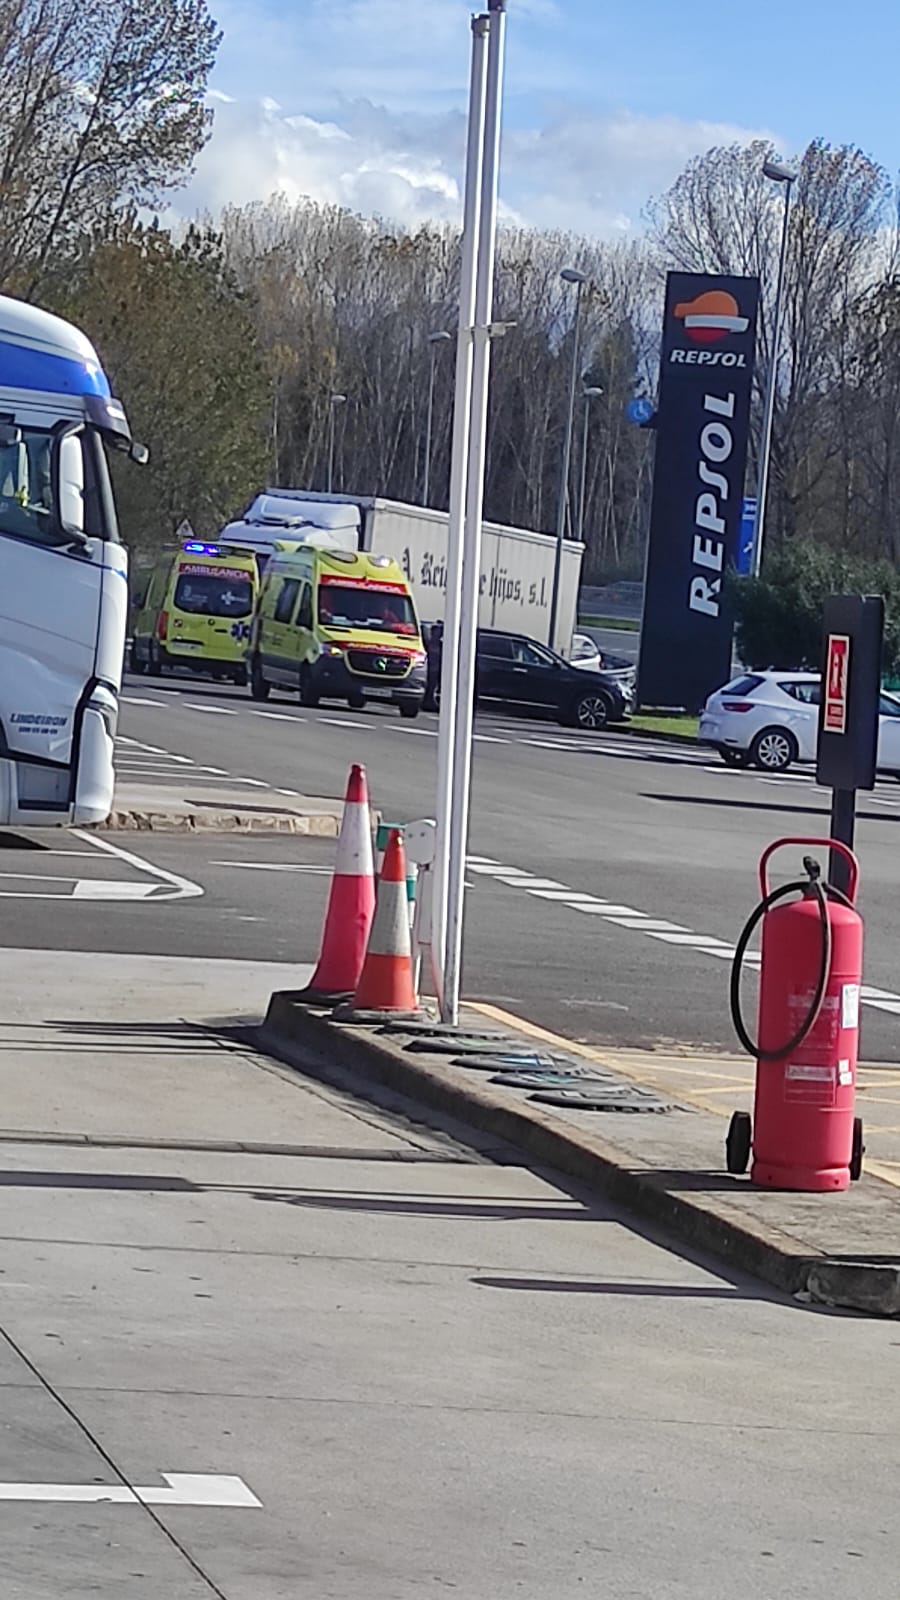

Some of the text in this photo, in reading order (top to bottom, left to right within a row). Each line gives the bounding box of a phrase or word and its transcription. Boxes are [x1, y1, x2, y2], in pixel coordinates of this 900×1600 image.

[669, 349, 747, 368] REPSOL
[689, 392, 735, 618] REPSOL
[489, 567, 524, 607] hijos,
[528, 577, 548, 609] s.l.
